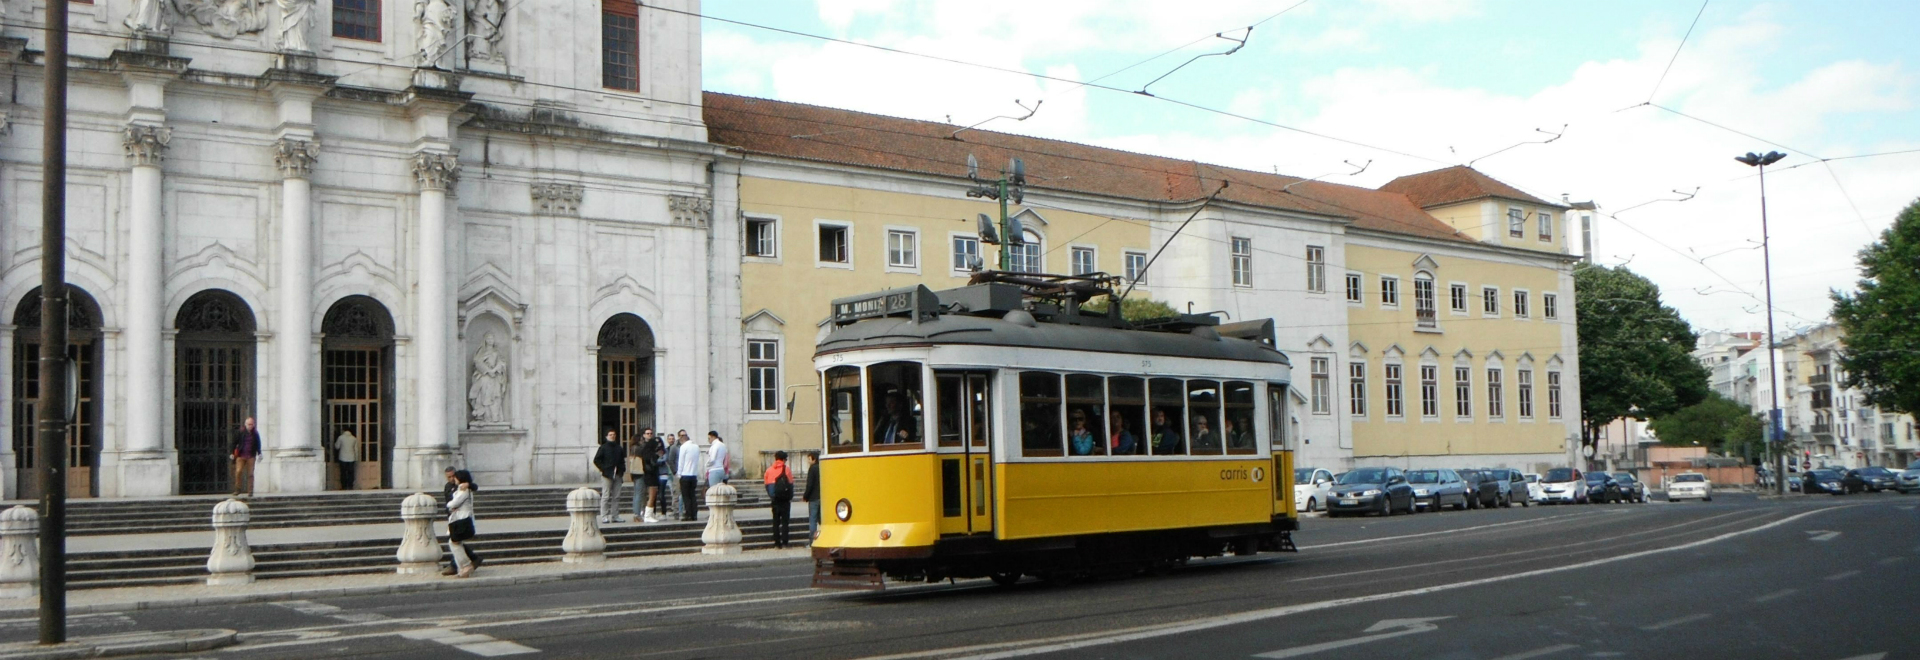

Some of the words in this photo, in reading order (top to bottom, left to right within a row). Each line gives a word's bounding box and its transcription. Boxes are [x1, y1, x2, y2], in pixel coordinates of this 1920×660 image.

[841, 303, 851, 315] M.
[891, 293, 907, 310] 28
[832, 354, 844, 363] 575
[1141, 360, 1152, 368] 575
[1220, 465, 1248, 480] carris
